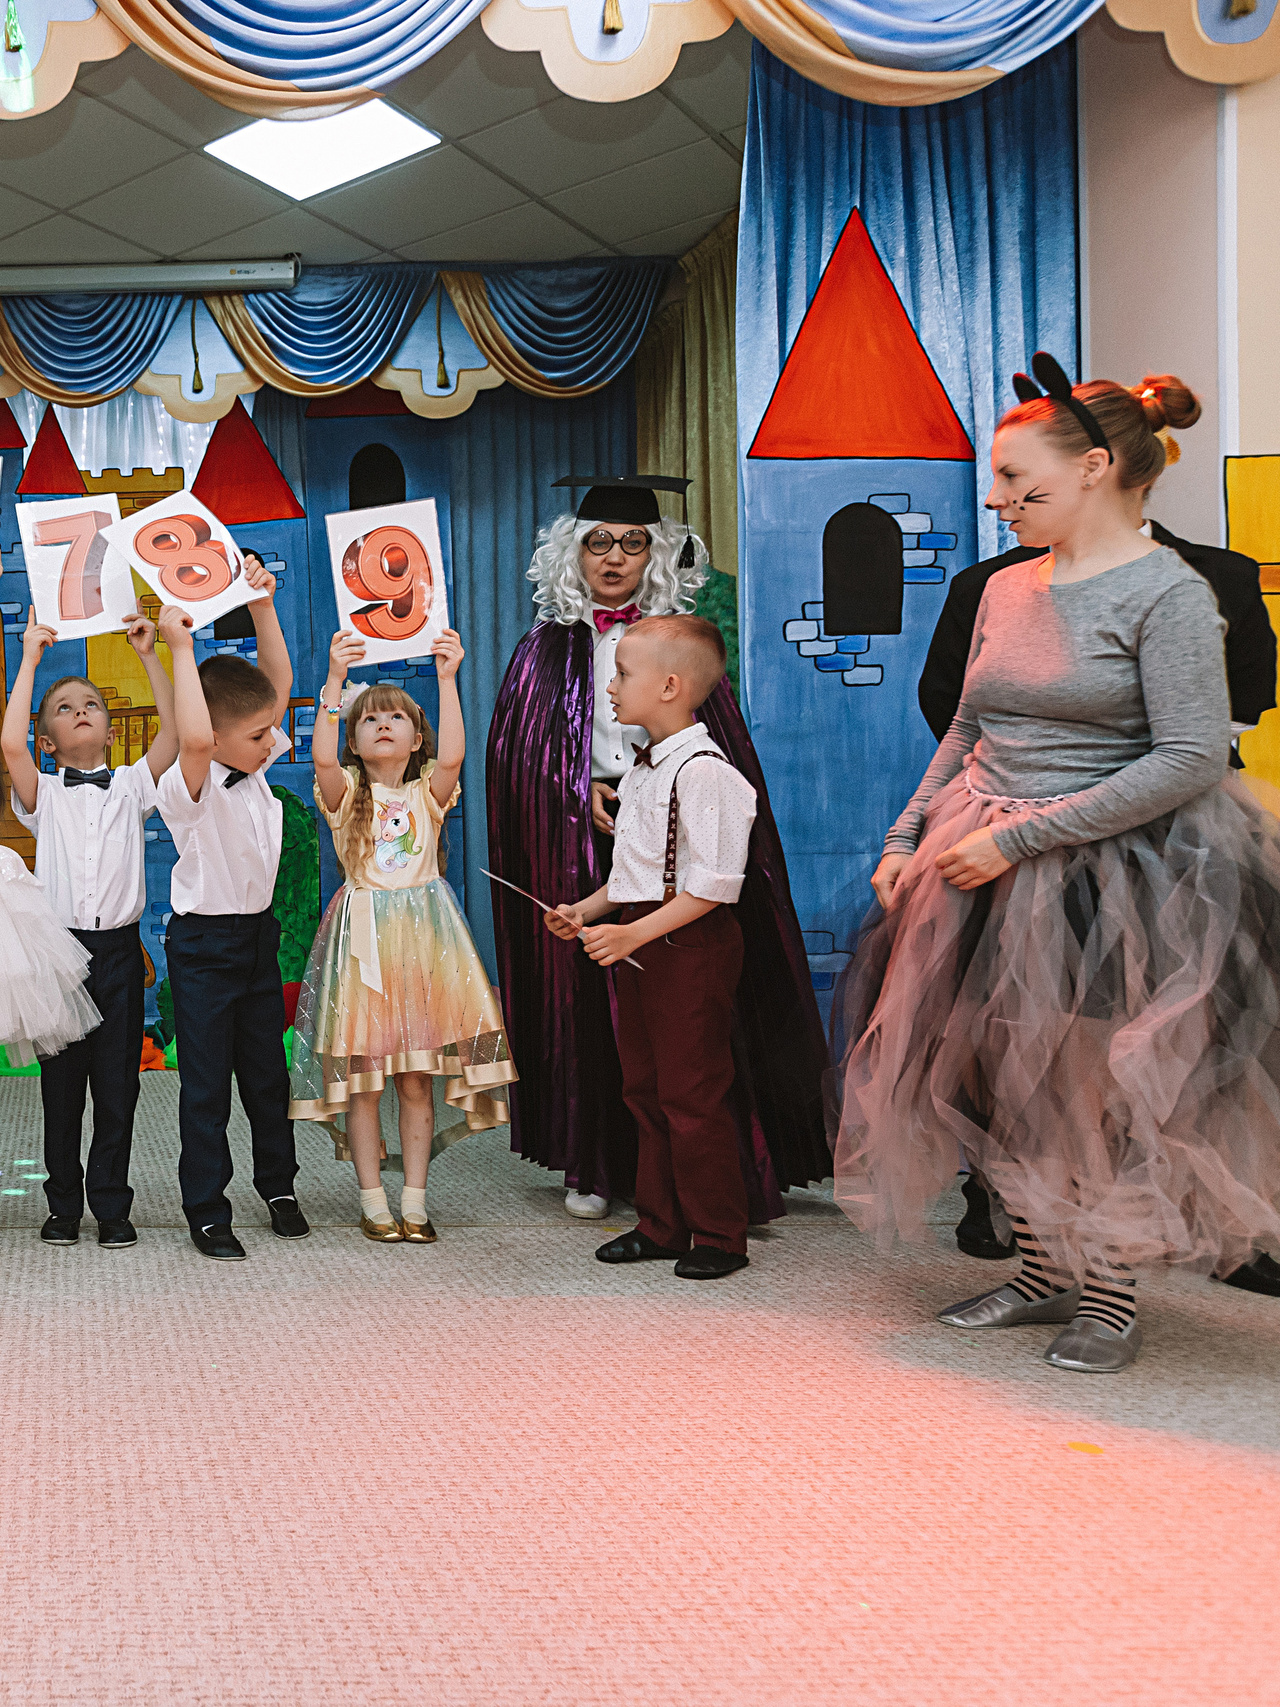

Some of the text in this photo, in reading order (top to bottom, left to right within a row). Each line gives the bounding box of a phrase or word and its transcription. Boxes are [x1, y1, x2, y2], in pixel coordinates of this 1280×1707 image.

[32, 510, 113, 621] 7
[133, 513, 241, 603] 8
[341, 525, 433, 641] 9
